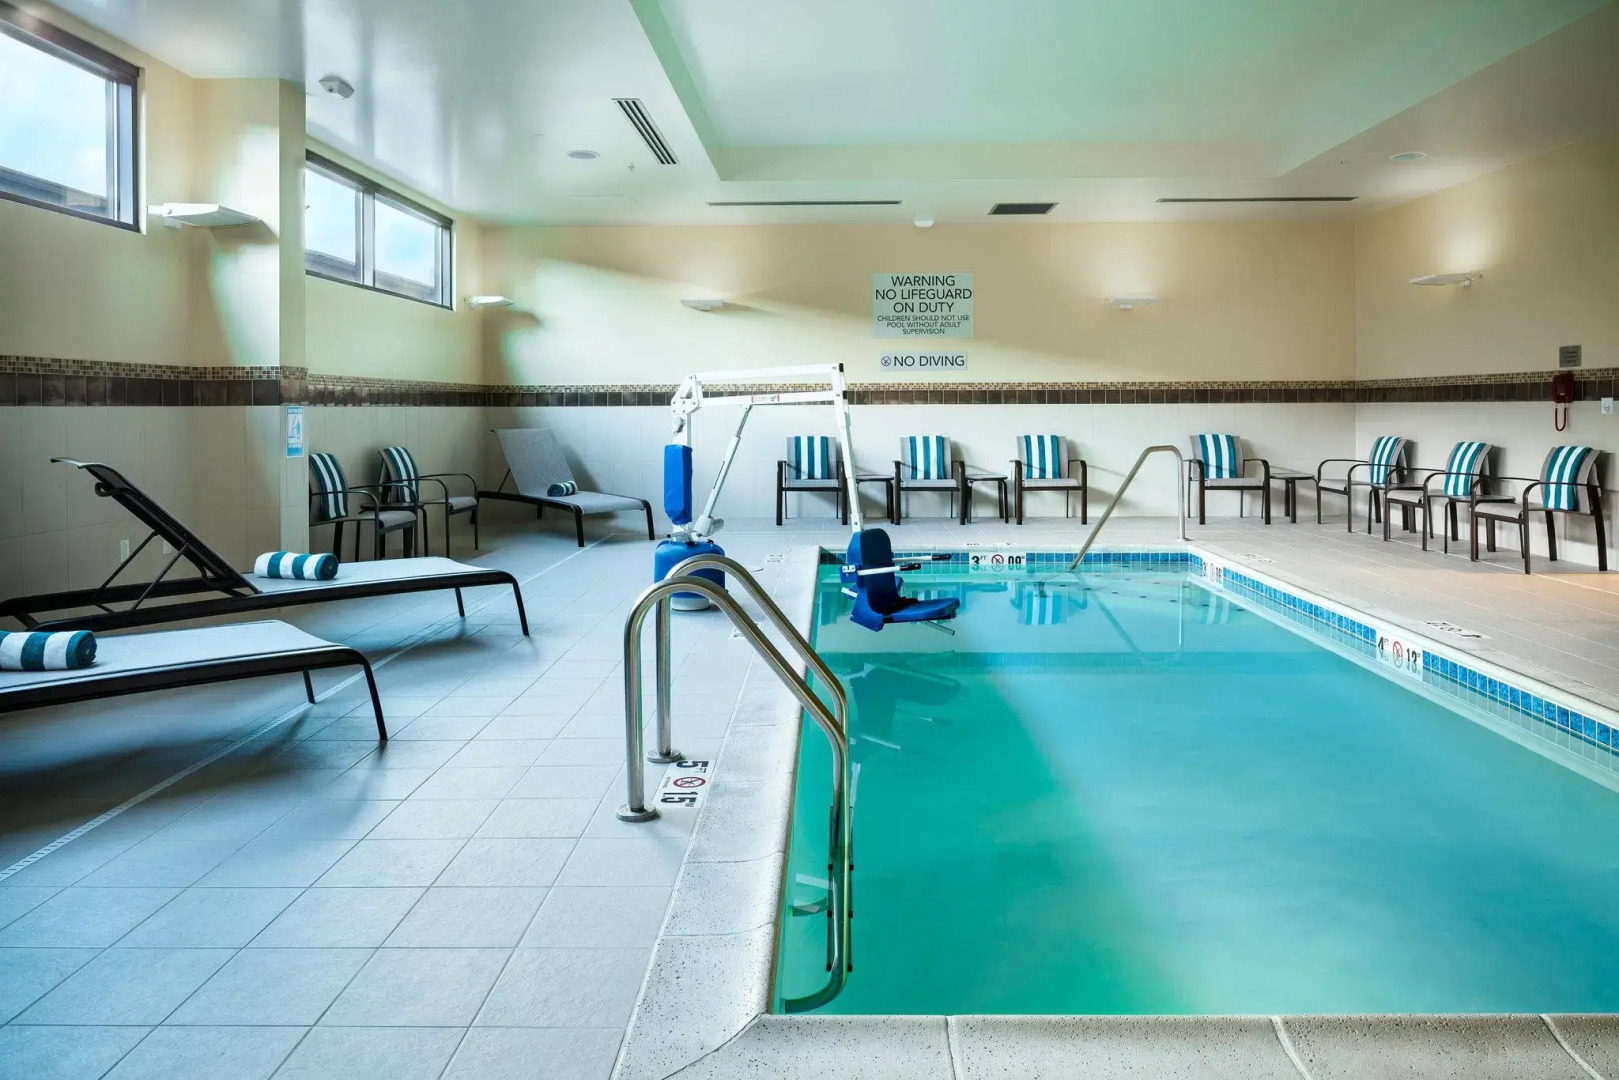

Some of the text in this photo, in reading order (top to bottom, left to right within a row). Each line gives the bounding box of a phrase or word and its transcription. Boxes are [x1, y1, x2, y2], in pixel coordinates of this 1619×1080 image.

[891, 275, 956, 287] WARNING
[875, 288, 972, 300] NO LIFEGUARD
[893, 302, 955, 313] ON DUTY
[893, 355, 965, 367] NO DIVING
[676, 761, 709, 769] 5
